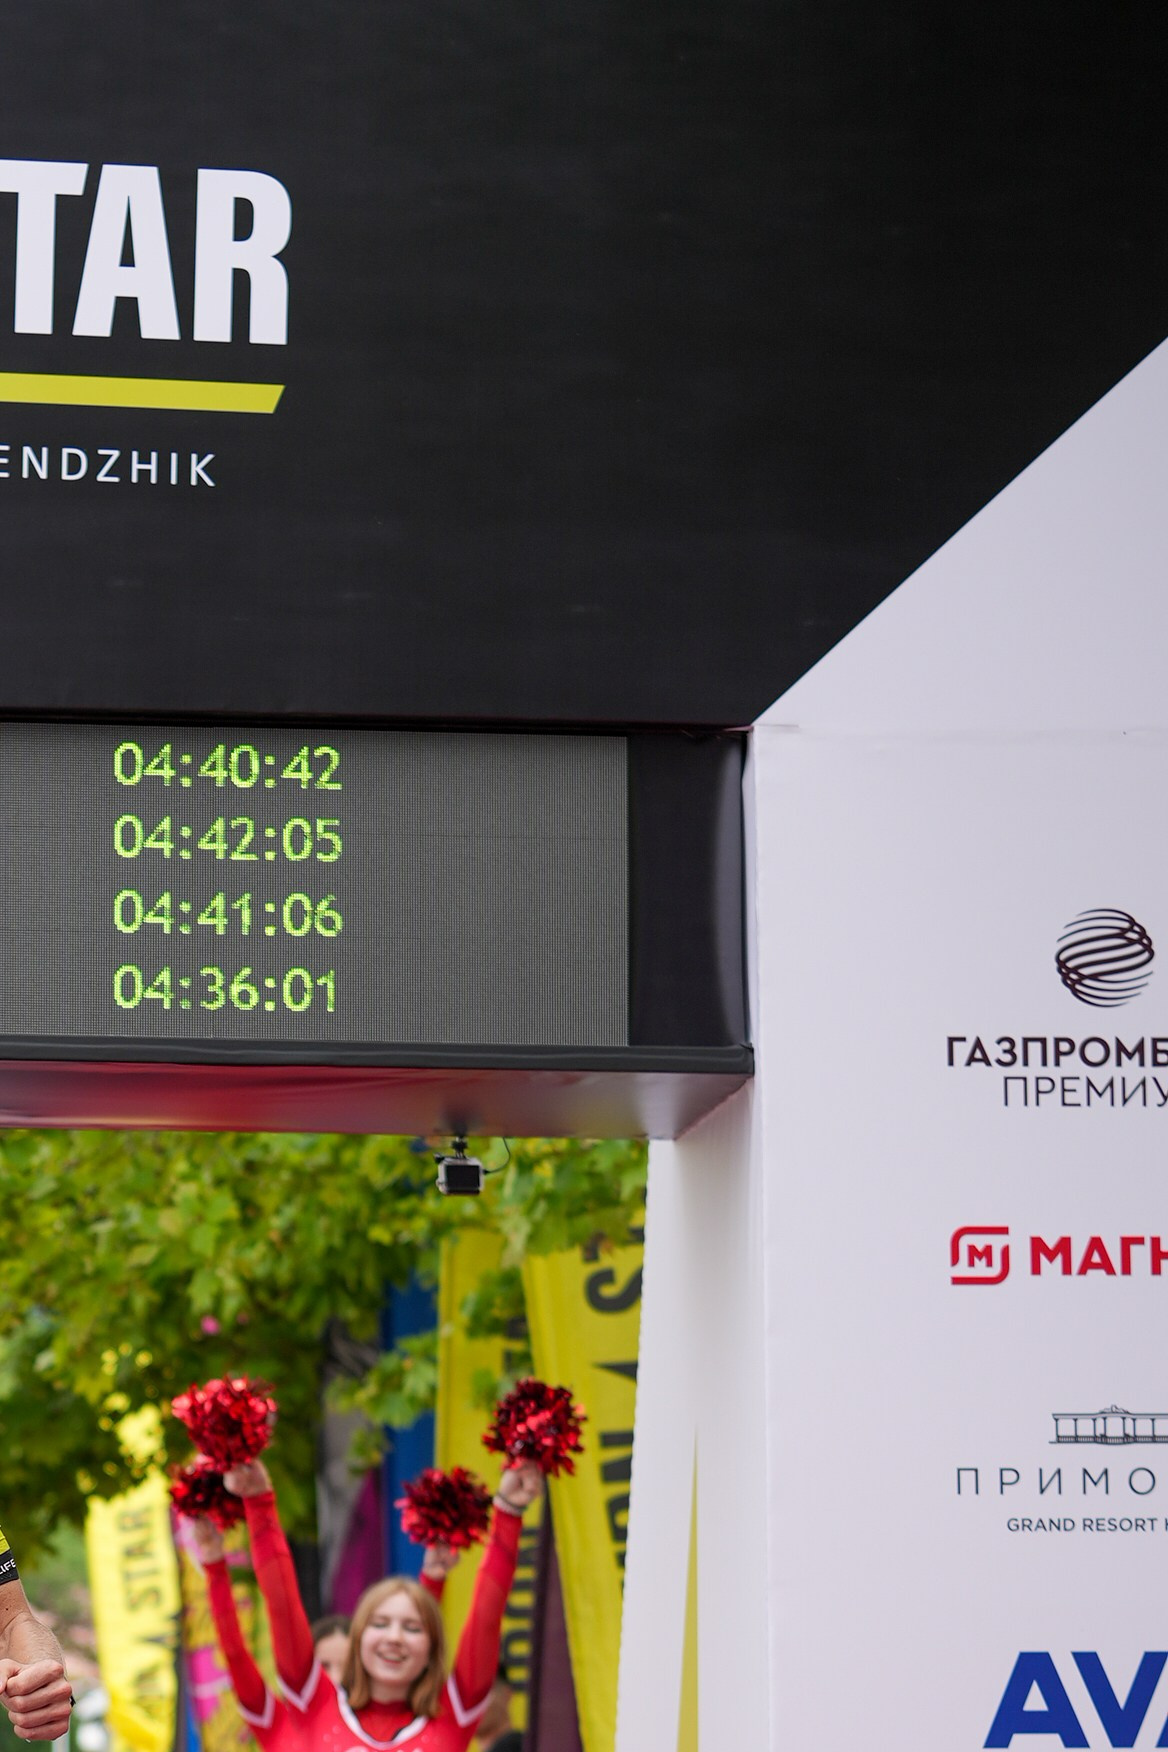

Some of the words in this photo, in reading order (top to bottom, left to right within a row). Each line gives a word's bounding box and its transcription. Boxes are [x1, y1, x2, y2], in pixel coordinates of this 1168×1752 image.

[113, 740, 343, 791] 04:40:42
[113, 814, 343, 863] 04:42:05
[113, 888, 343, 937] 04:41:06
[113, 963, 336, 1013] 04:36:01
[956, 1467, 1156, 1496] ПРИМО
[1006, 1517, 1076, 1533] GRAND
[1081, 1517, 1158, 1533] RESORT
[983, 1651, 1168, 1749] AV
